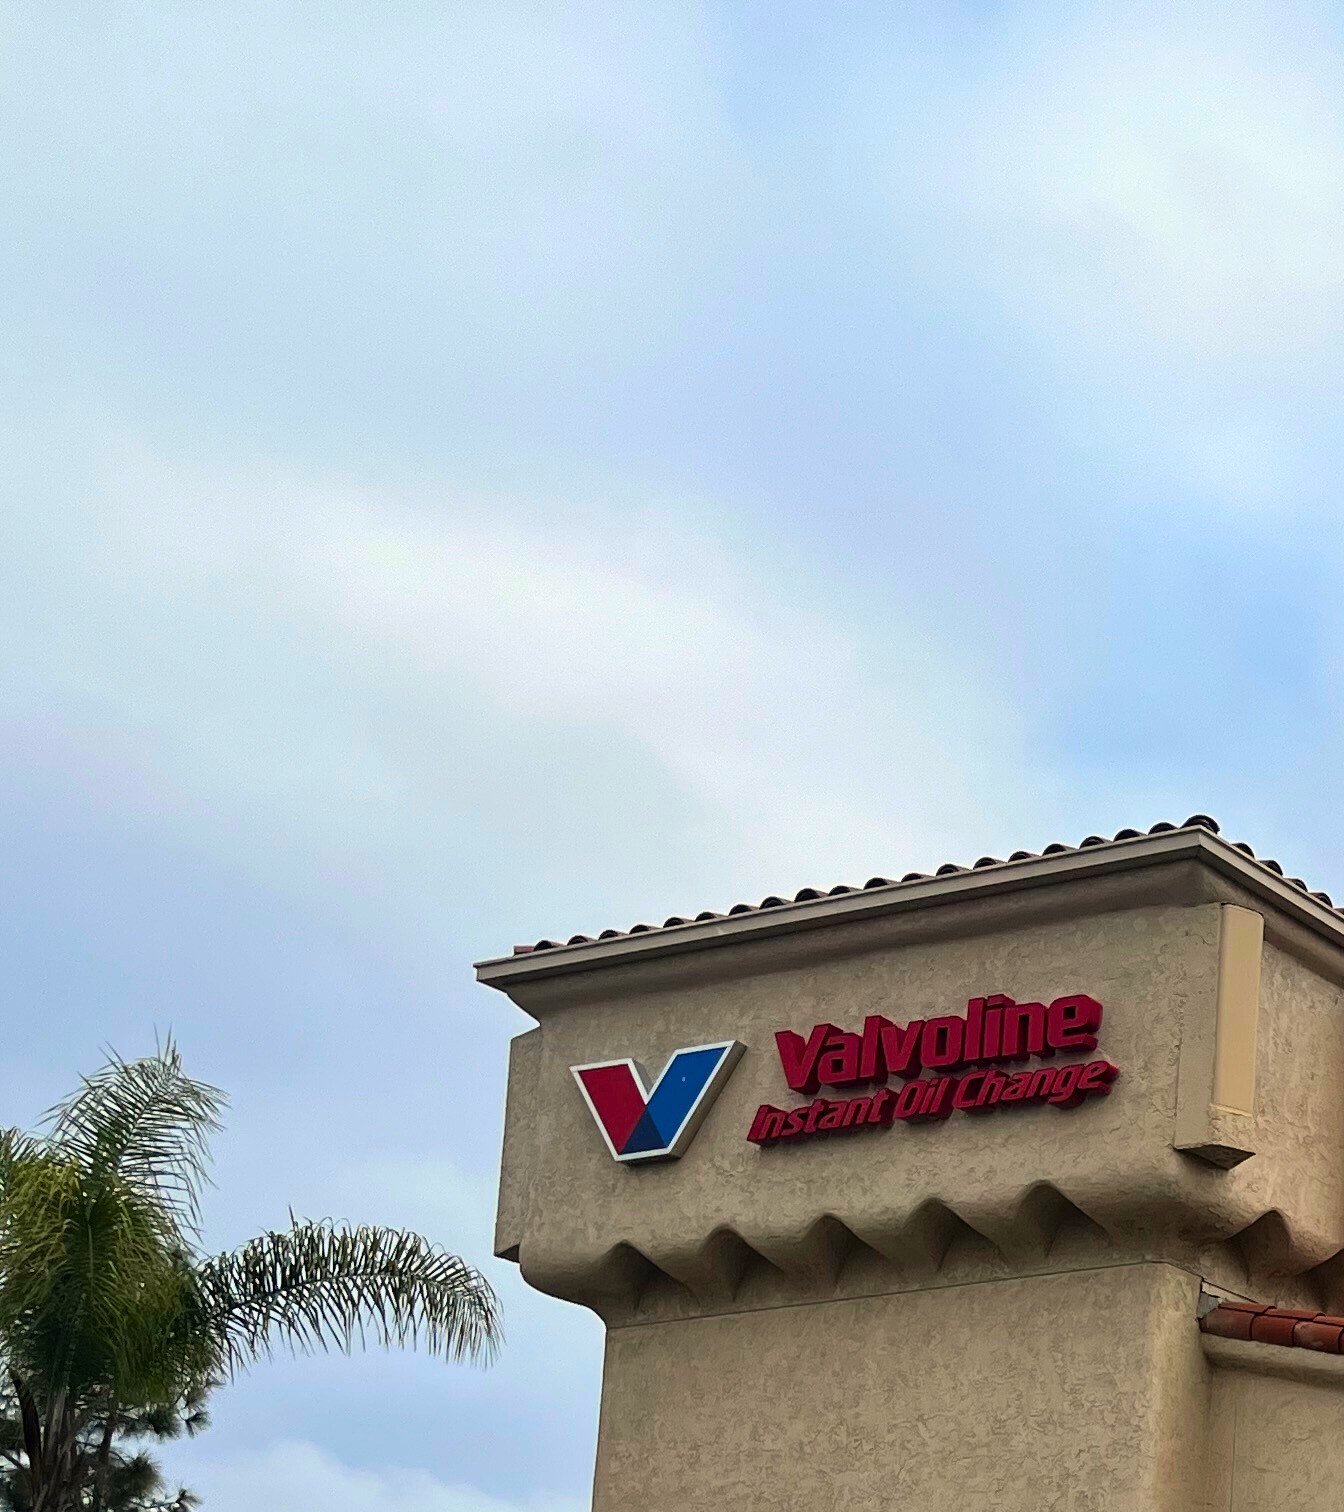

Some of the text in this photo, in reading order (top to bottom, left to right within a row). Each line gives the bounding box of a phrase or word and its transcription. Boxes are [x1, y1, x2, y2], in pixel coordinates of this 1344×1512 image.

[775, 994, 1103, 1094] Valvoline
[747, 1060, 1120, 1141] Instant Oil Change
